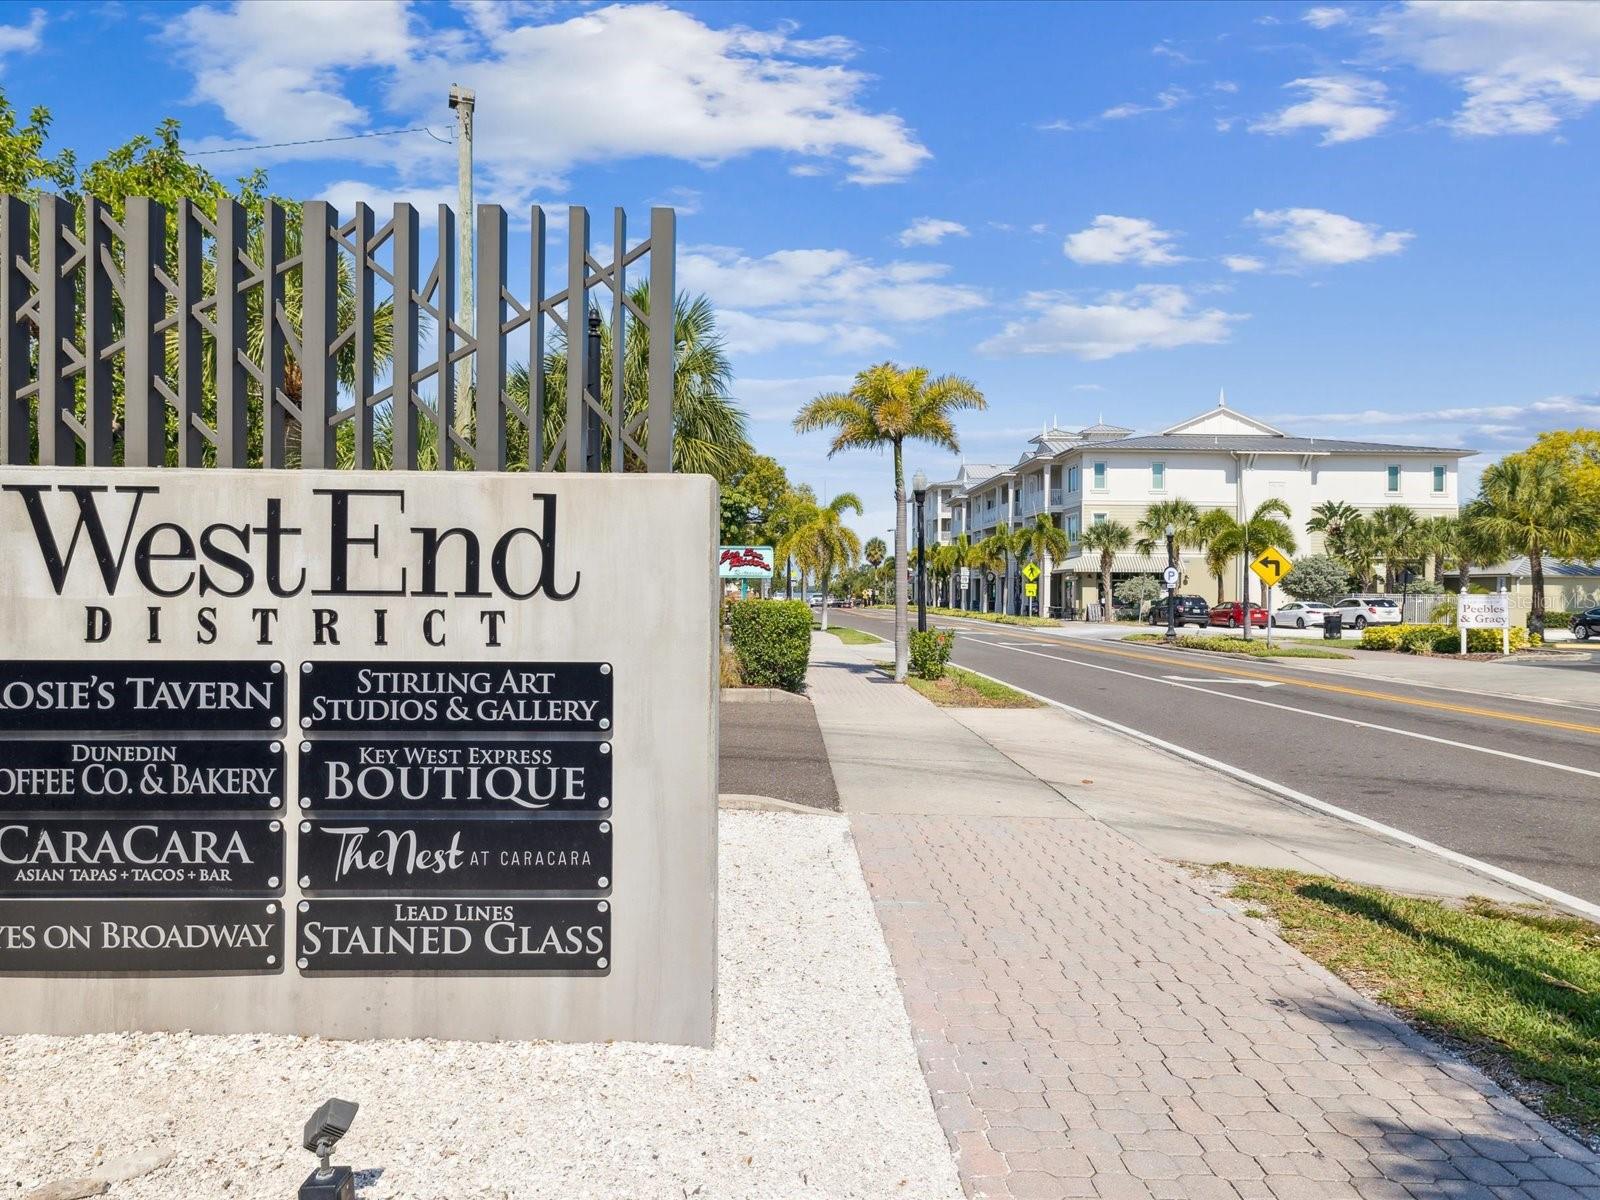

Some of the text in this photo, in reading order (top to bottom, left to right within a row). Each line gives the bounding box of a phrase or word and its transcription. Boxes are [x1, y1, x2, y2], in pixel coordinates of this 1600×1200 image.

[1460, 614, 1470, 622] &
[1463, 604, 1504, 613] Peebles
[84, 605, 506, 646] DISTRICT
[0, 675, 273, 709] OSIE'S TAVERN
[357, 669, 555, 693] STIRLING ART
[312, 696, 599, 721] STUDIOS & GALLERY
[72, 745, 177, 762] DUNEDIN
[359, 747, 552, 764] KEY WEST EXPRESS
[0, 764, 277, 795] OFFEE CO. & BAKERY
[324, 761, 586, 808] BOUTIQUE
[470, 851, 489, 865] AT
[501, 851, 591, 865] CARACARA
[15, 869, 64, 881] ASIAN
[70, 869, 116, 881] TAPAS
[131, 869, 184, 881] TACOS
[200, 869, 232, 881] BAR
[395, 904, 513, 921] LEAD LINES
[44, 926, 92, 949] ON
[101, 922, 274, 949] BROADWAY
[303, 922, 603, 954] STAINED GLASS
